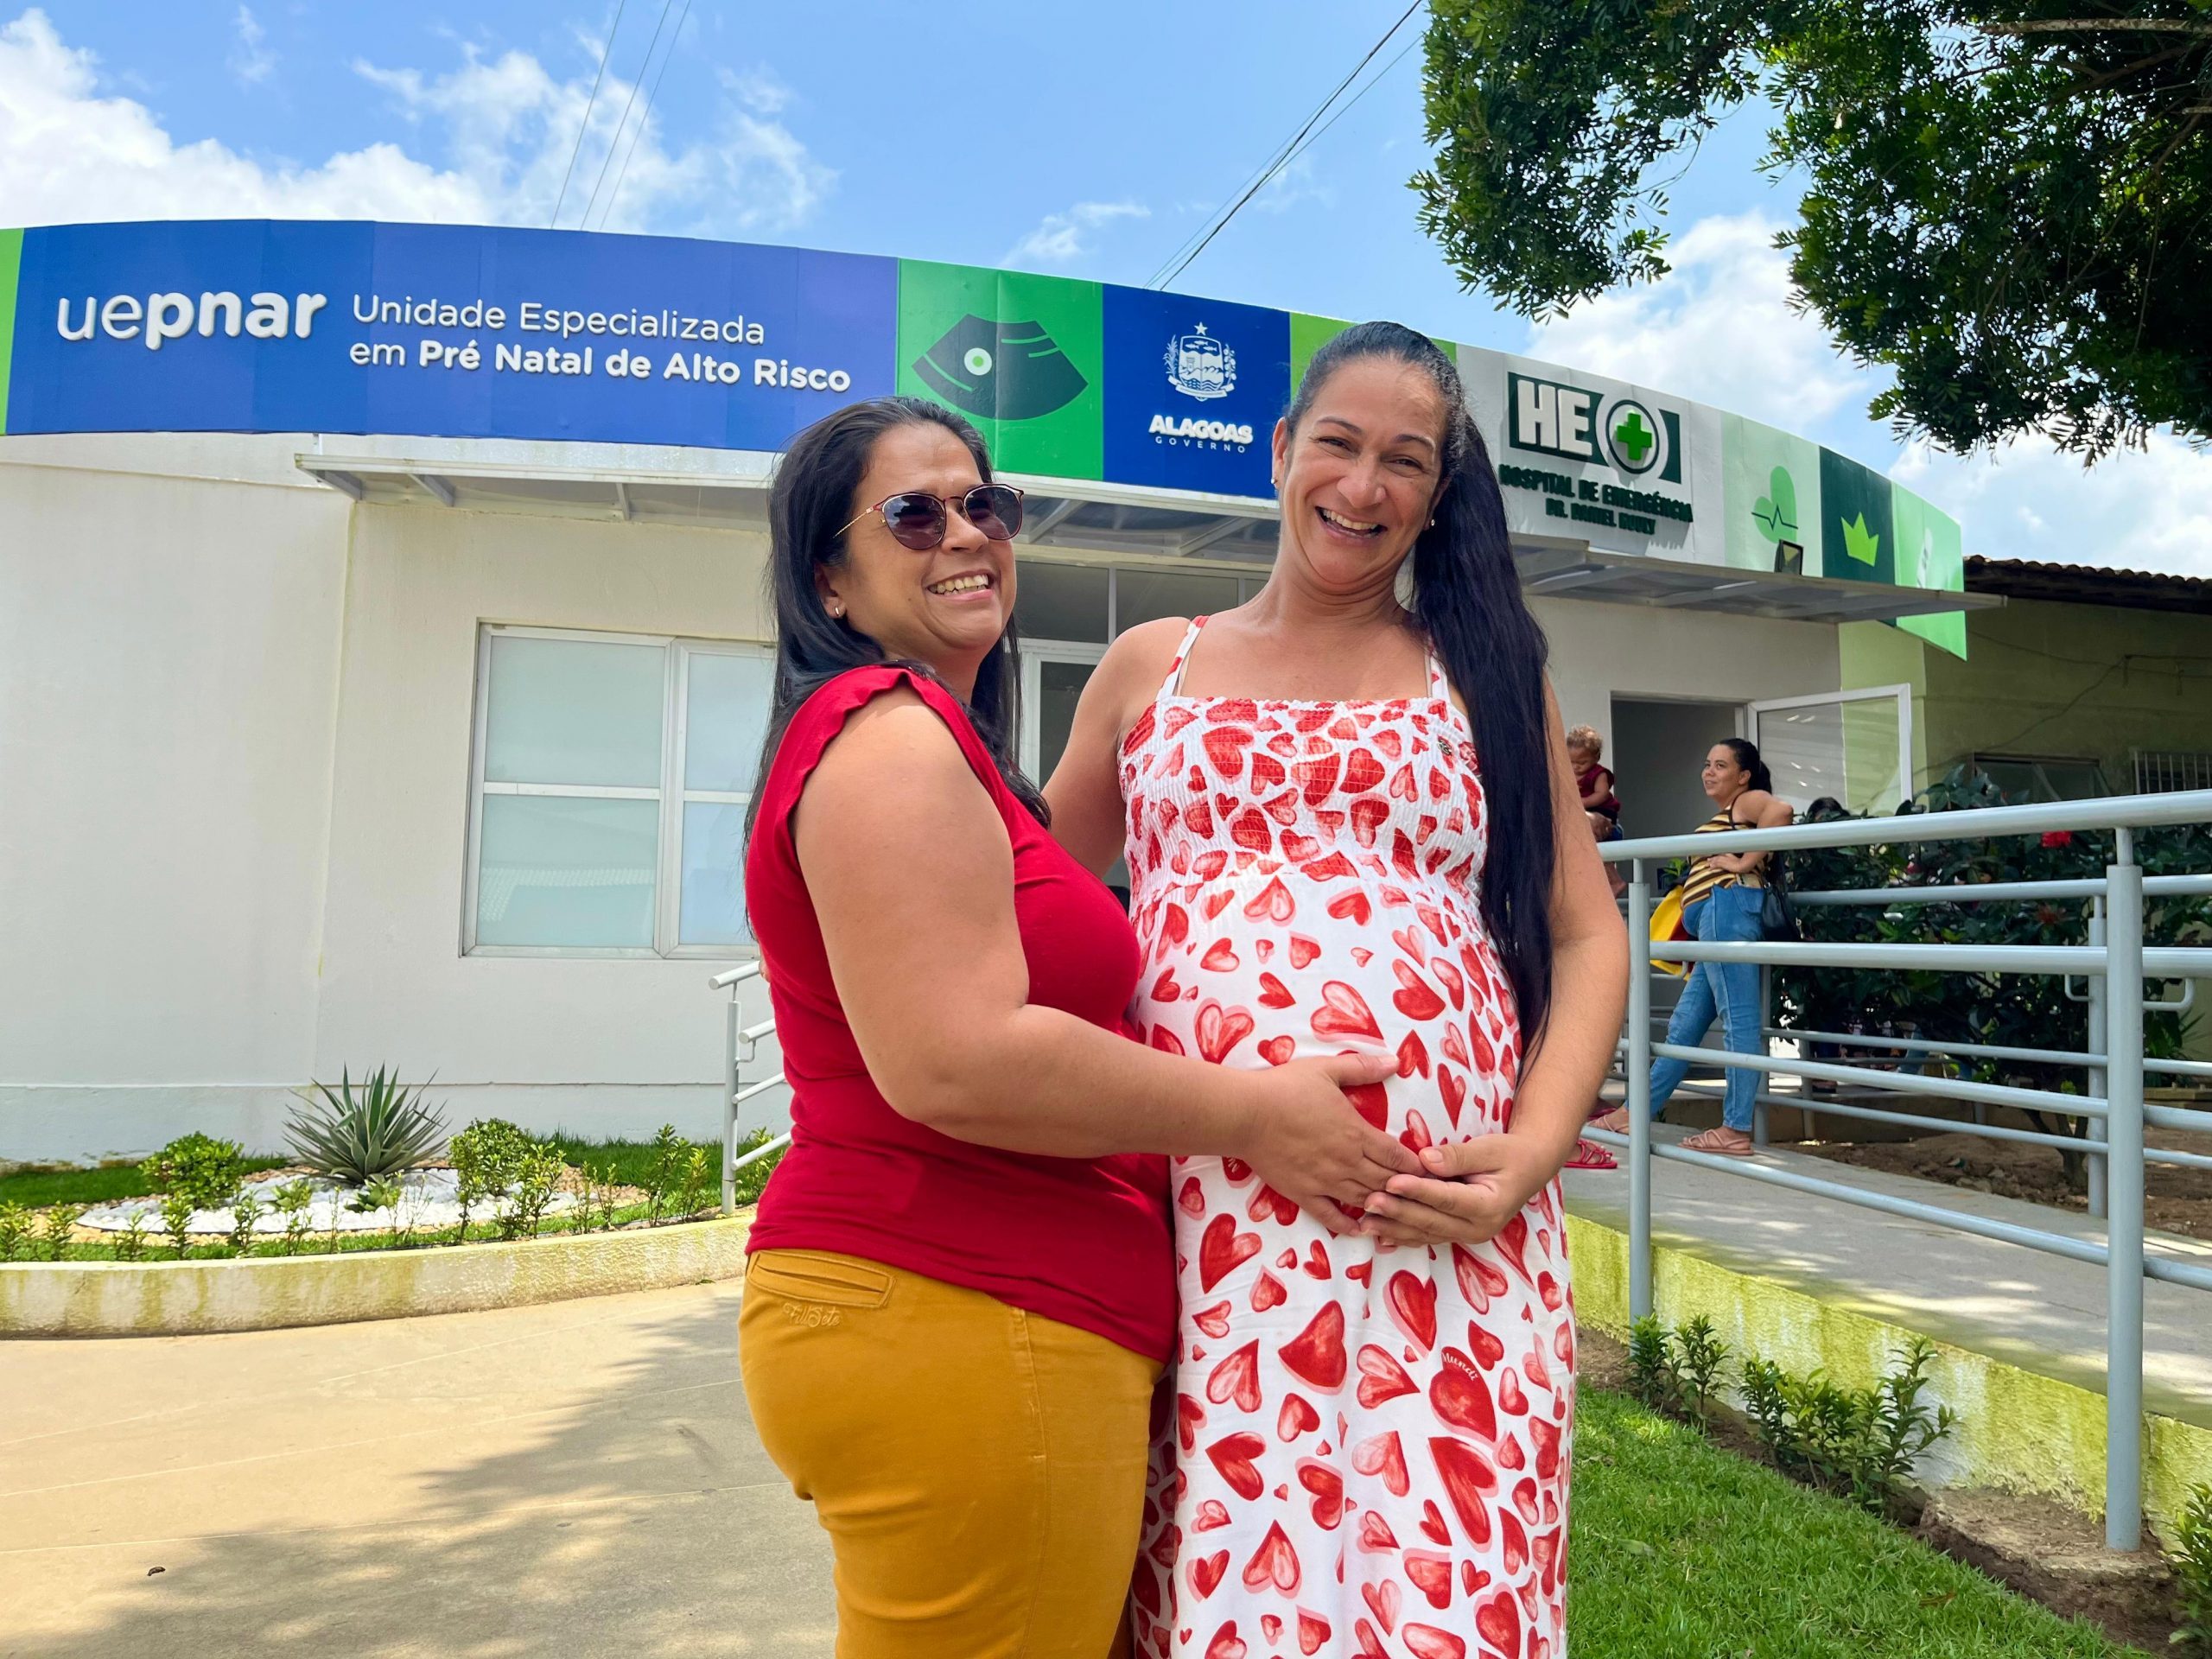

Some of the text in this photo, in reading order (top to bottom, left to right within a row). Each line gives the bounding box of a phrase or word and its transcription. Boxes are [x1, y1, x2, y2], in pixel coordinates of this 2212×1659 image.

[57, 291, 327, 350] uepnar
[353, 294, 765, 345] Unidade Especializada
[350, 339, 851, 393] em Pré Natal de Alto Risco
[1148, 415, 1254, 444] ALAGOAS
[1154, 435, 1246, 454] GOVERNO
[1498, 464, 1575, 498] HOSPITAL
[1578, 479, 1599, 502] DE
